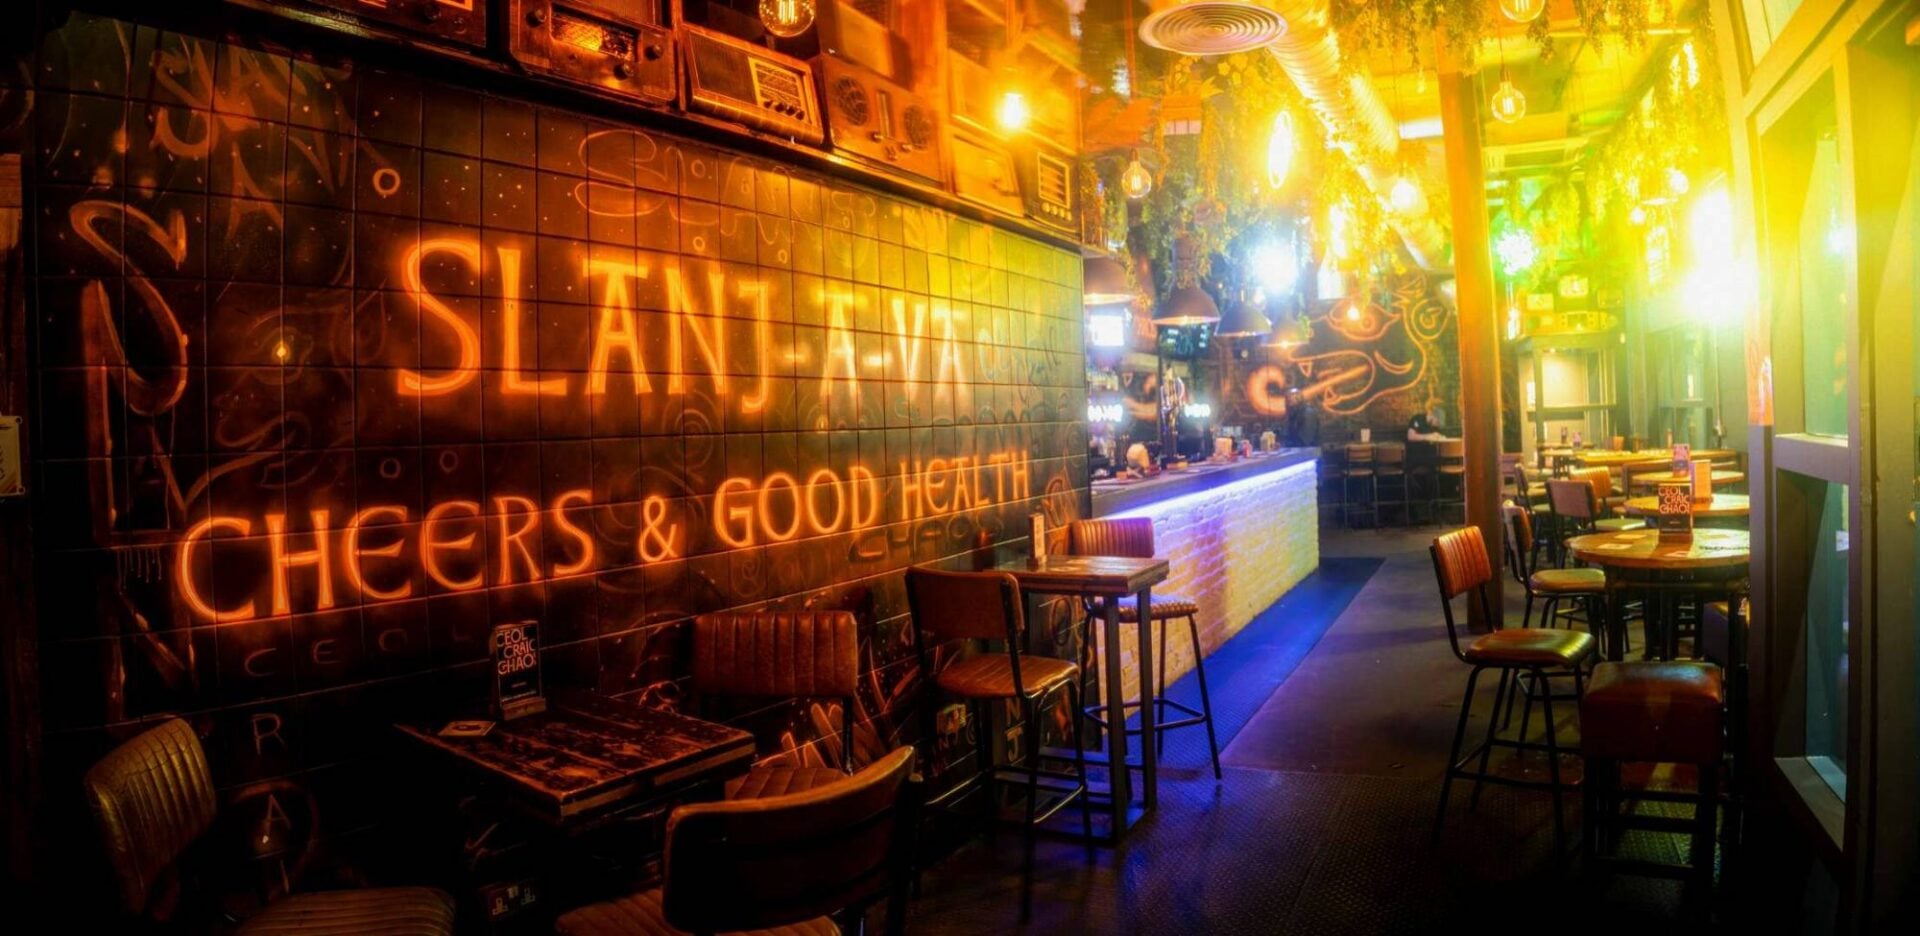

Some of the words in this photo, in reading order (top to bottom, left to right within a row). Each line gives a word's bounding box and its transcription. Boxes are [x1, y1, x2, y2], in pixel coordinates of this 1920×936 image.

[397, 236, 970, 413] SLANJ-A-VA
[177, 489, 598, 622] CHEERS
[638, 494, 679, 564] &
[713, 464, 880, 550] GOOD
[901, 449, 1030, 522] HEALTH
[496, 626, 528, 648] CEOL
[503, 638, 537, 659] CRAIC
